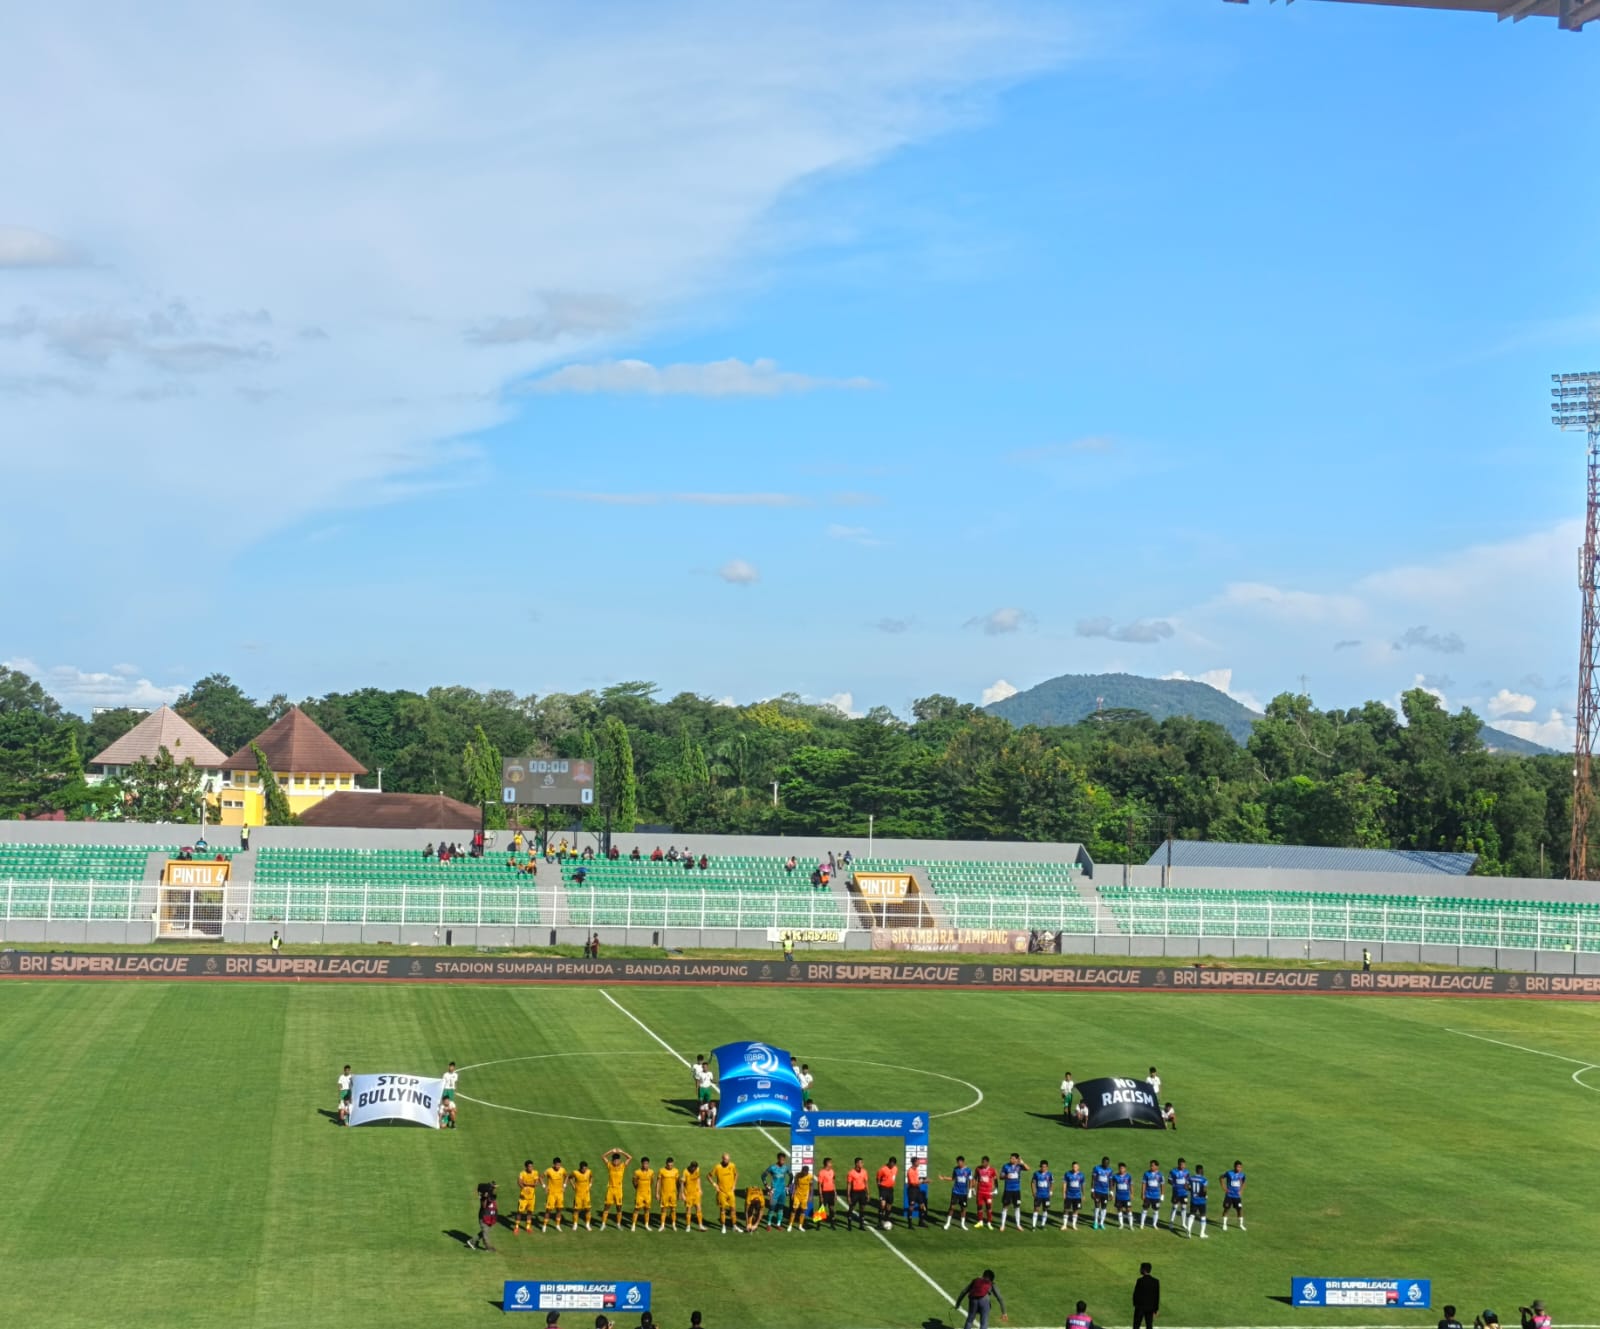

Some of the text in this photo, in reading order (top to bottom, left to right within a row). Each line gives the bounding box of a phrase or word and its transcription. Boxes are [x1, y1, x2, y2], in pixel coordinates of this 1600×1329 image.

[173, 867, 224, 884] PINTU 4
[860, 879, 895, 895] PINTU
[891, 928, 1008, 945] SIKAMBARA LAMPUNG
[19, 955, 48, 972] BRI
[225, 957, 252, 974] BRI
[434, 961, 494, 974] STADION
[497, 962, 553, 975] SUMPAH
[556, 963, 614, 976] PEMUDA
[625, 964, 681, 976] BANDAR
[684, 964, 748, 977] LAMPUNG
[807, 964, 833, 980] BRI
[992, 967, 1017, 983] BRI
[1173, 970, 1197, 986] BRI
[1350, 973, 1374, 988] BRI
[1525, 976, 1549, 991] BRI
[377, 1075, 420, 1086] STOP
[1114, 1079, 1136, 1088] NO
[358, 1087, 432, 1110] BULLYING
[1101, 1089, 1154, 1107] RACISM
[817, 1119, 835, 1128] BRI
[1192, 1182, 1200, 1193] 11
[540, 1284, 555, 1292] BRI
[1325, 1281, 1340, 1289] BRI
